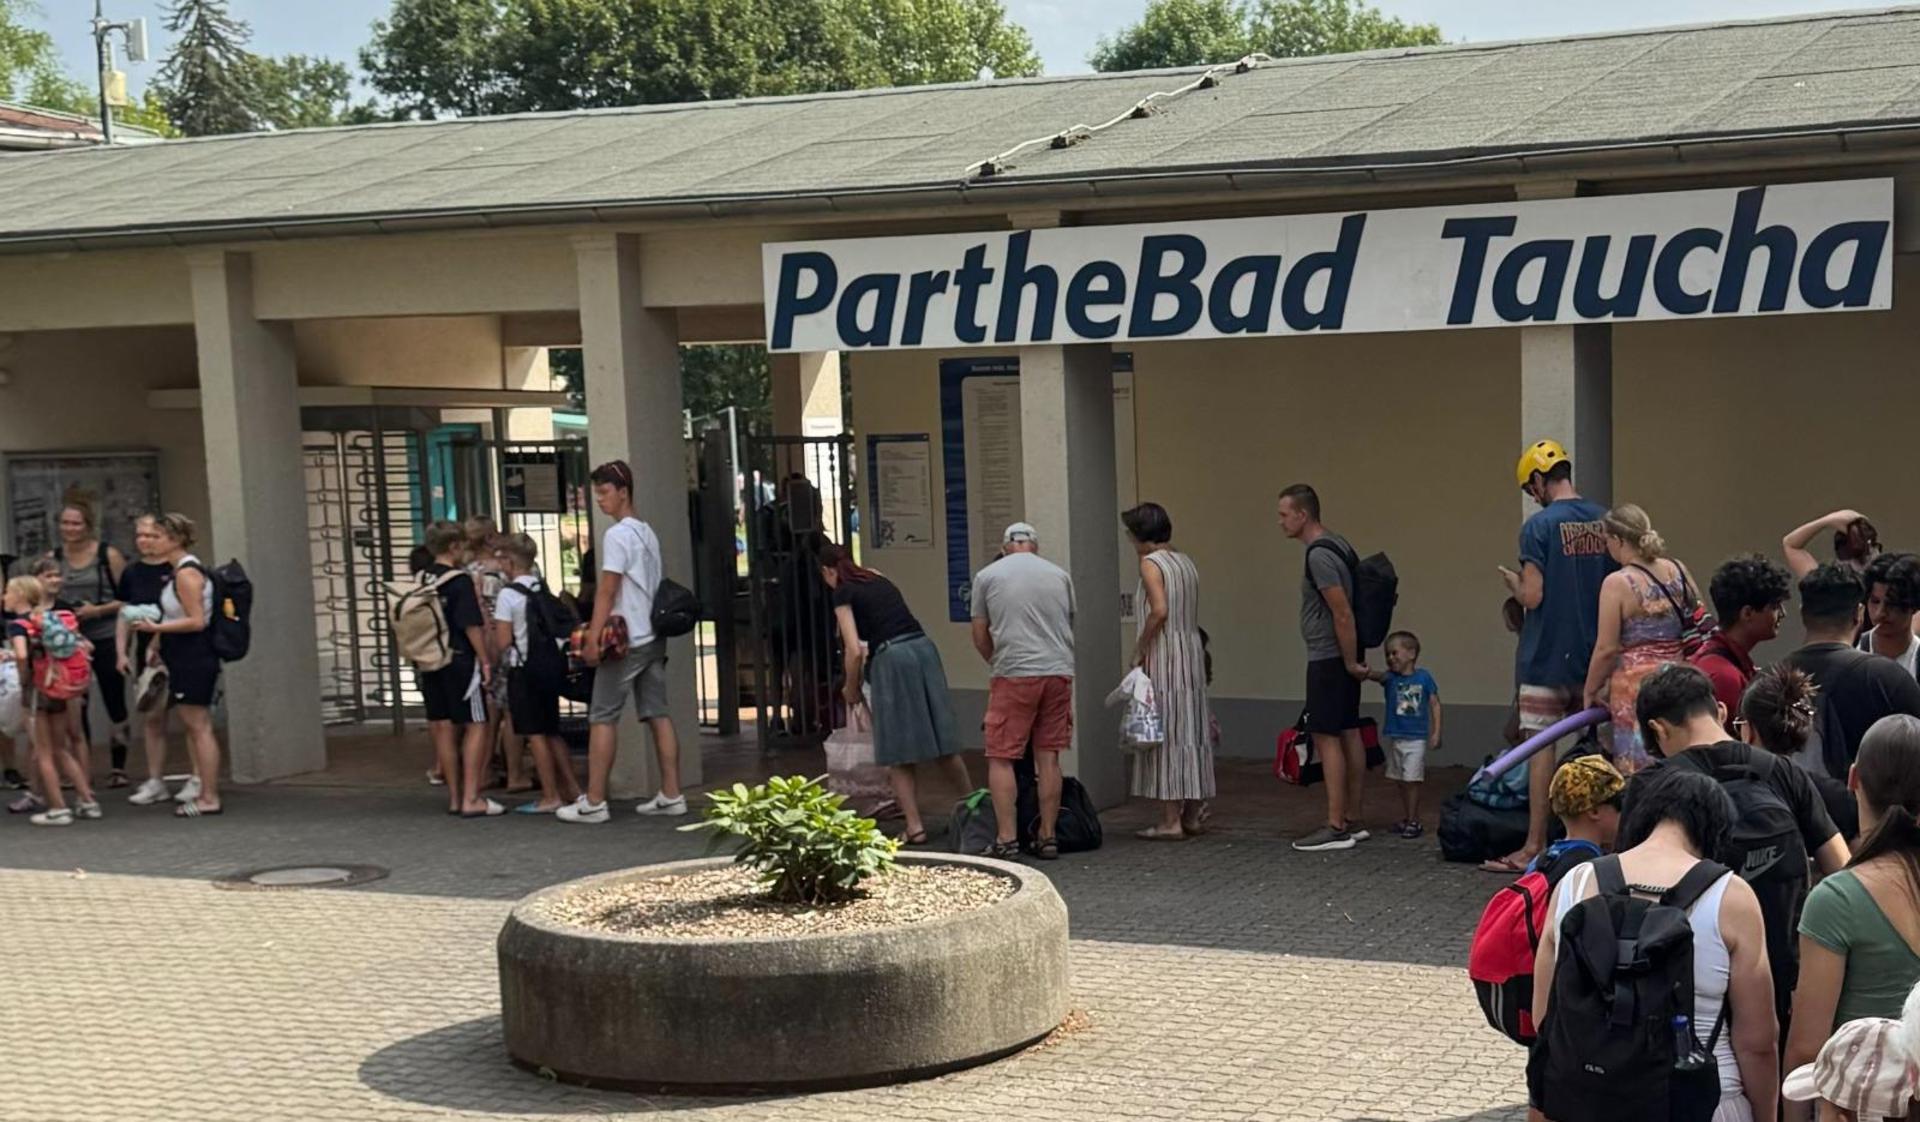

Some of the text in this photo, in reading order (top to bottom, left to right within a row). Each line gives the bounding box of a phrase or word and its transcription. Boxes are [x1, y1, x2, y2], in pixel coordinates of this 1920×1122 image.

[771, 187, 1888, 350] PartheBad Taucha
[1745, 846, 1778, 868] NIKE
